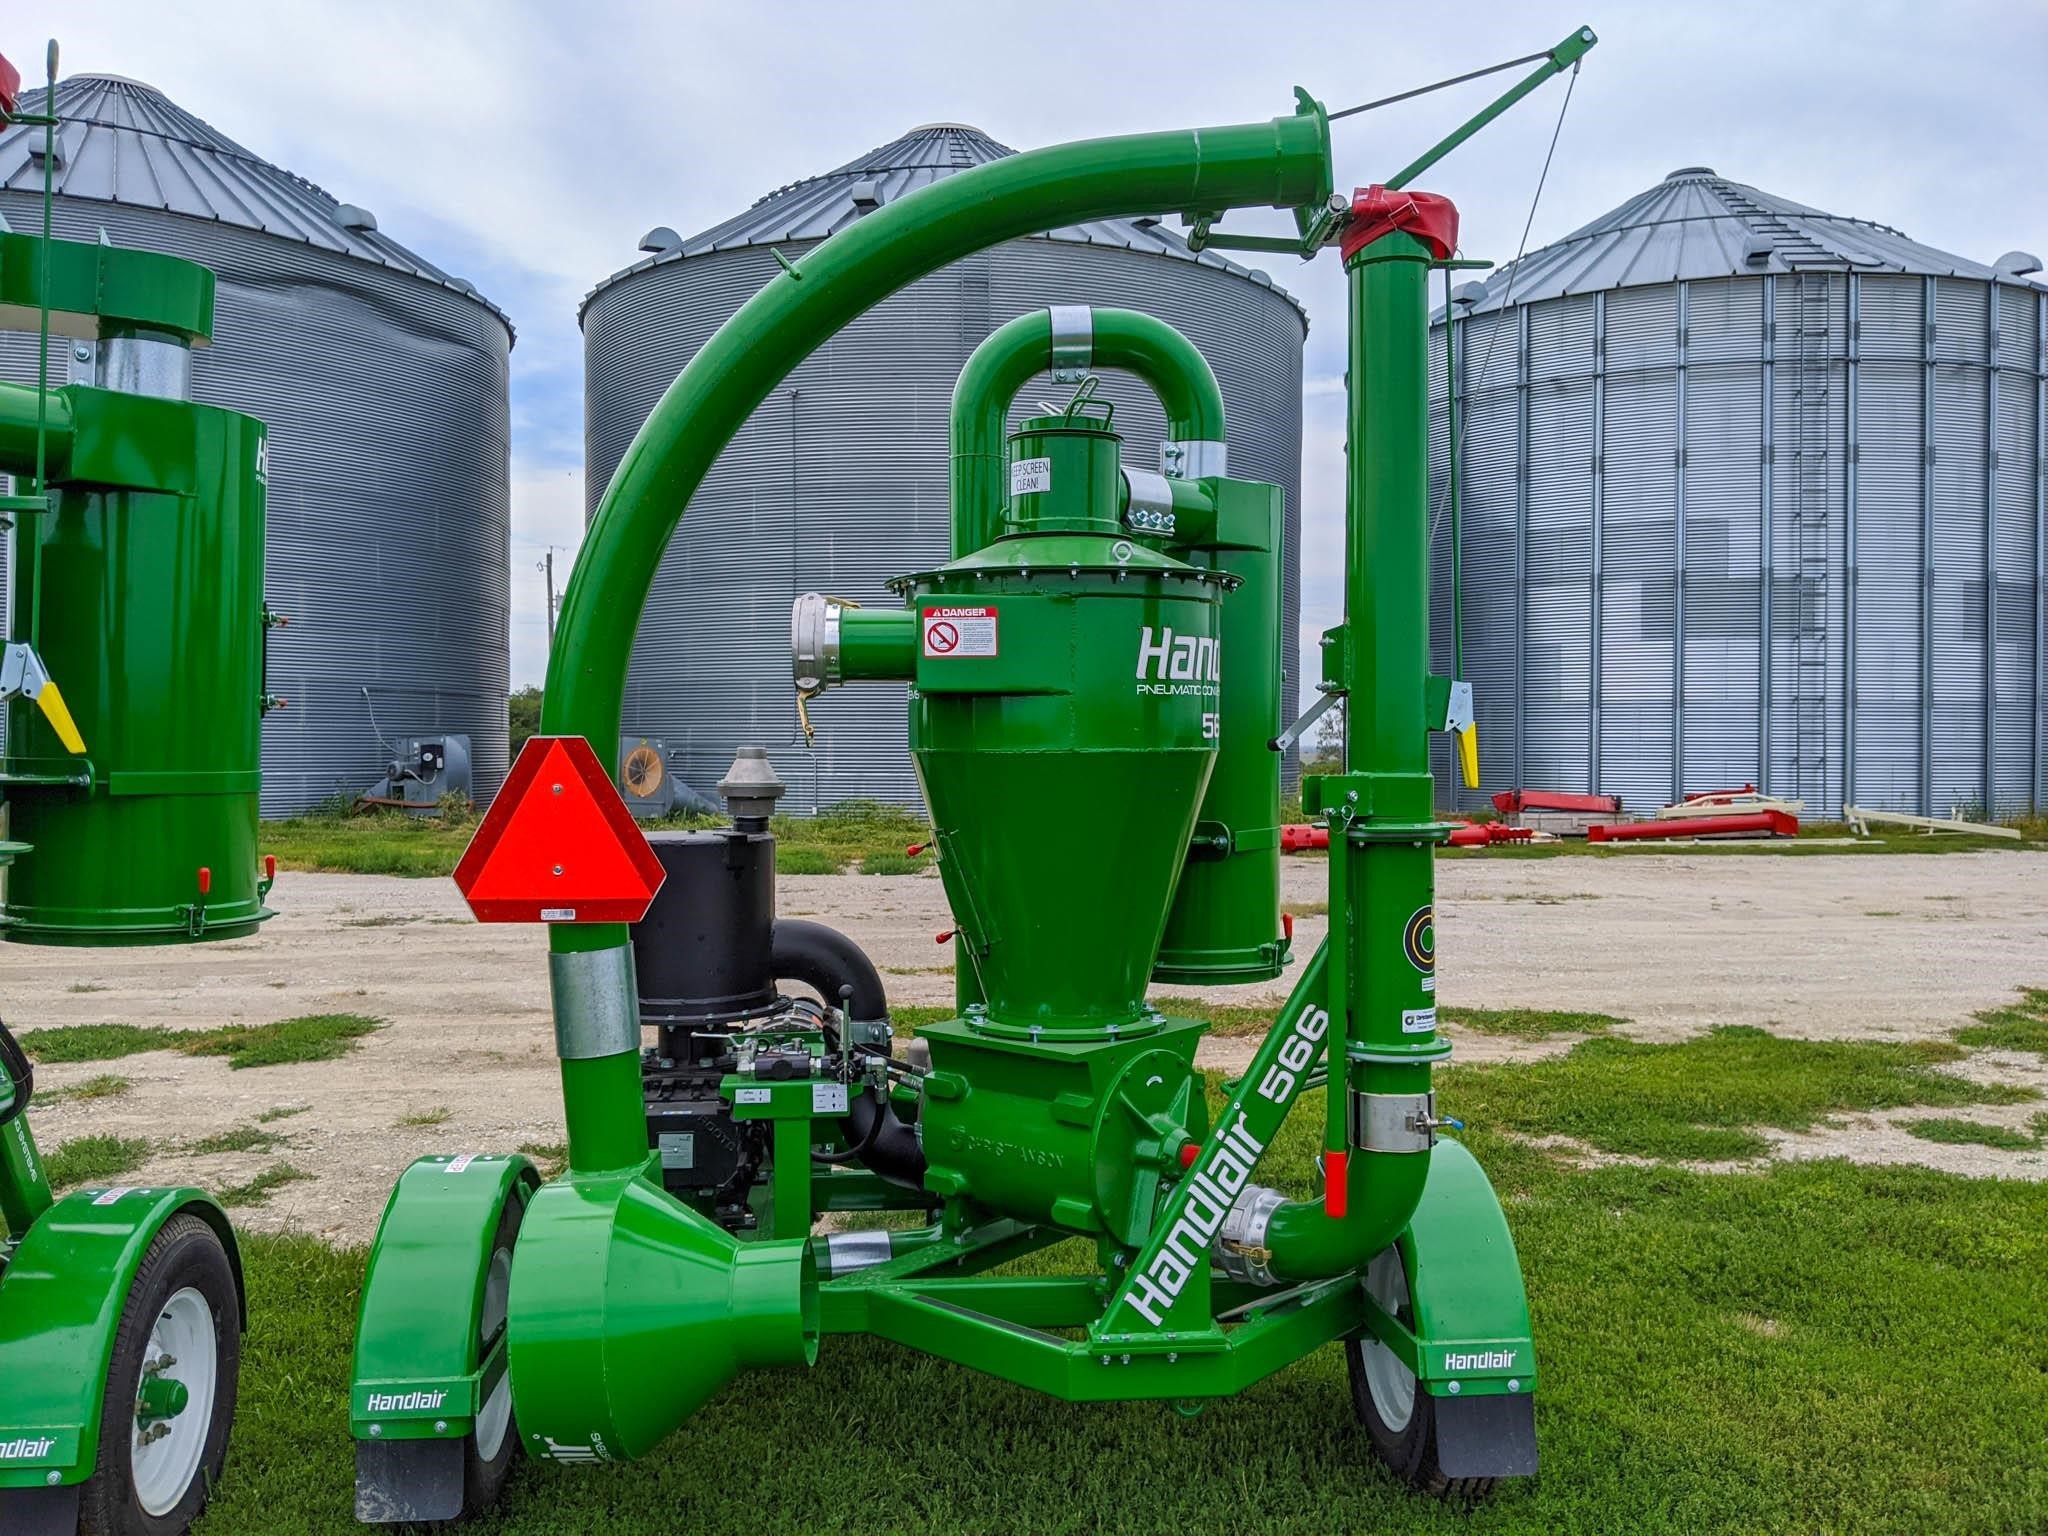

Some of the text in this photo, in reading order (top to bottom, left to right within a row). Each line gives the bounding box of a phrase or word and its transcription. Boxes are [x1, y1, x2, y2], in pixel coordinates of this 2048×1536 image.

[1023, 461, 1049, 475] SCREEN
[1016, 477, 1039, 491] CLEAN!
[942, 608, 986, 616] DANGER
[1136, 684, 1202, 696] PNEUMATIC
[1123, 1003, 1328, 1328] Handlair 566
[1444, 1348, 1518, 1371] Handlair
[367, 1389, 448, 1412] Handlair
